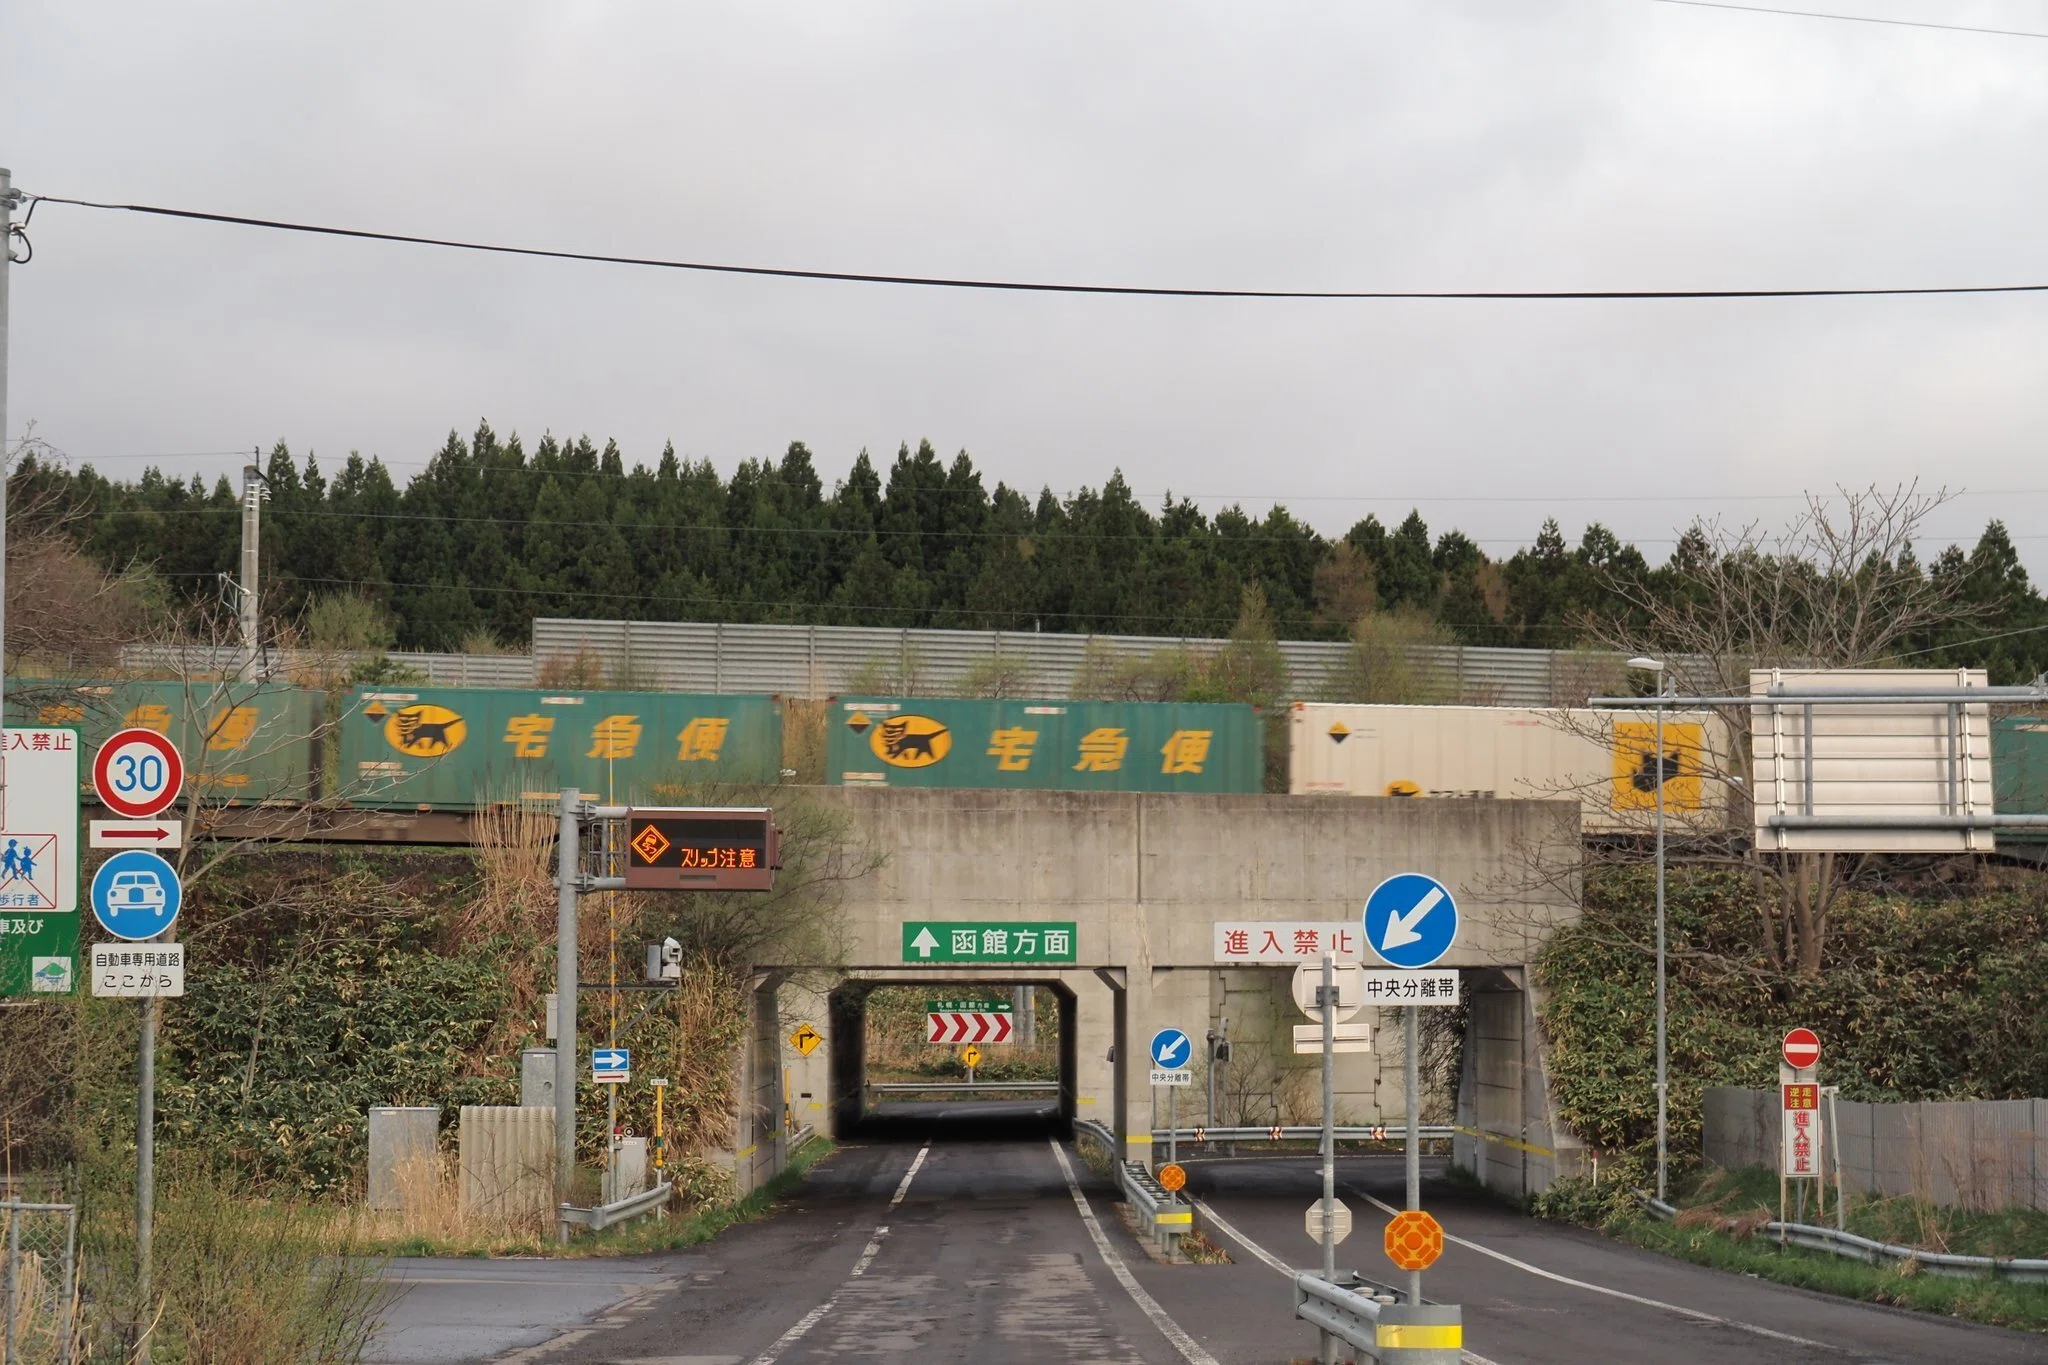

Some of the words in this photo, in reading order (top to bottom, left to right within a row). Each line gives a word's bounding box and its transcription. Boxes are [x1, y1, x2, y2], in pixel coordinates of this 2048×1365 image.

[503, 713, 730, 761] 宅急便
[986, 726, 1213, 774] 宅急便
[115, 755, 162, 792] 30
[951, 929, 1069, 955] 函館方面
[1224, 929, 1353, 955] 進入禁止
[96, 952, 180, 967] 自動車専用道路
[104, 974, 172, 988] ここから
[1367, 978, 1454, 998] 中央分離帯
[1790, 1098, 1812, 1108] 注意
[1793, 1111, 1810, 1173] 進入禁止
